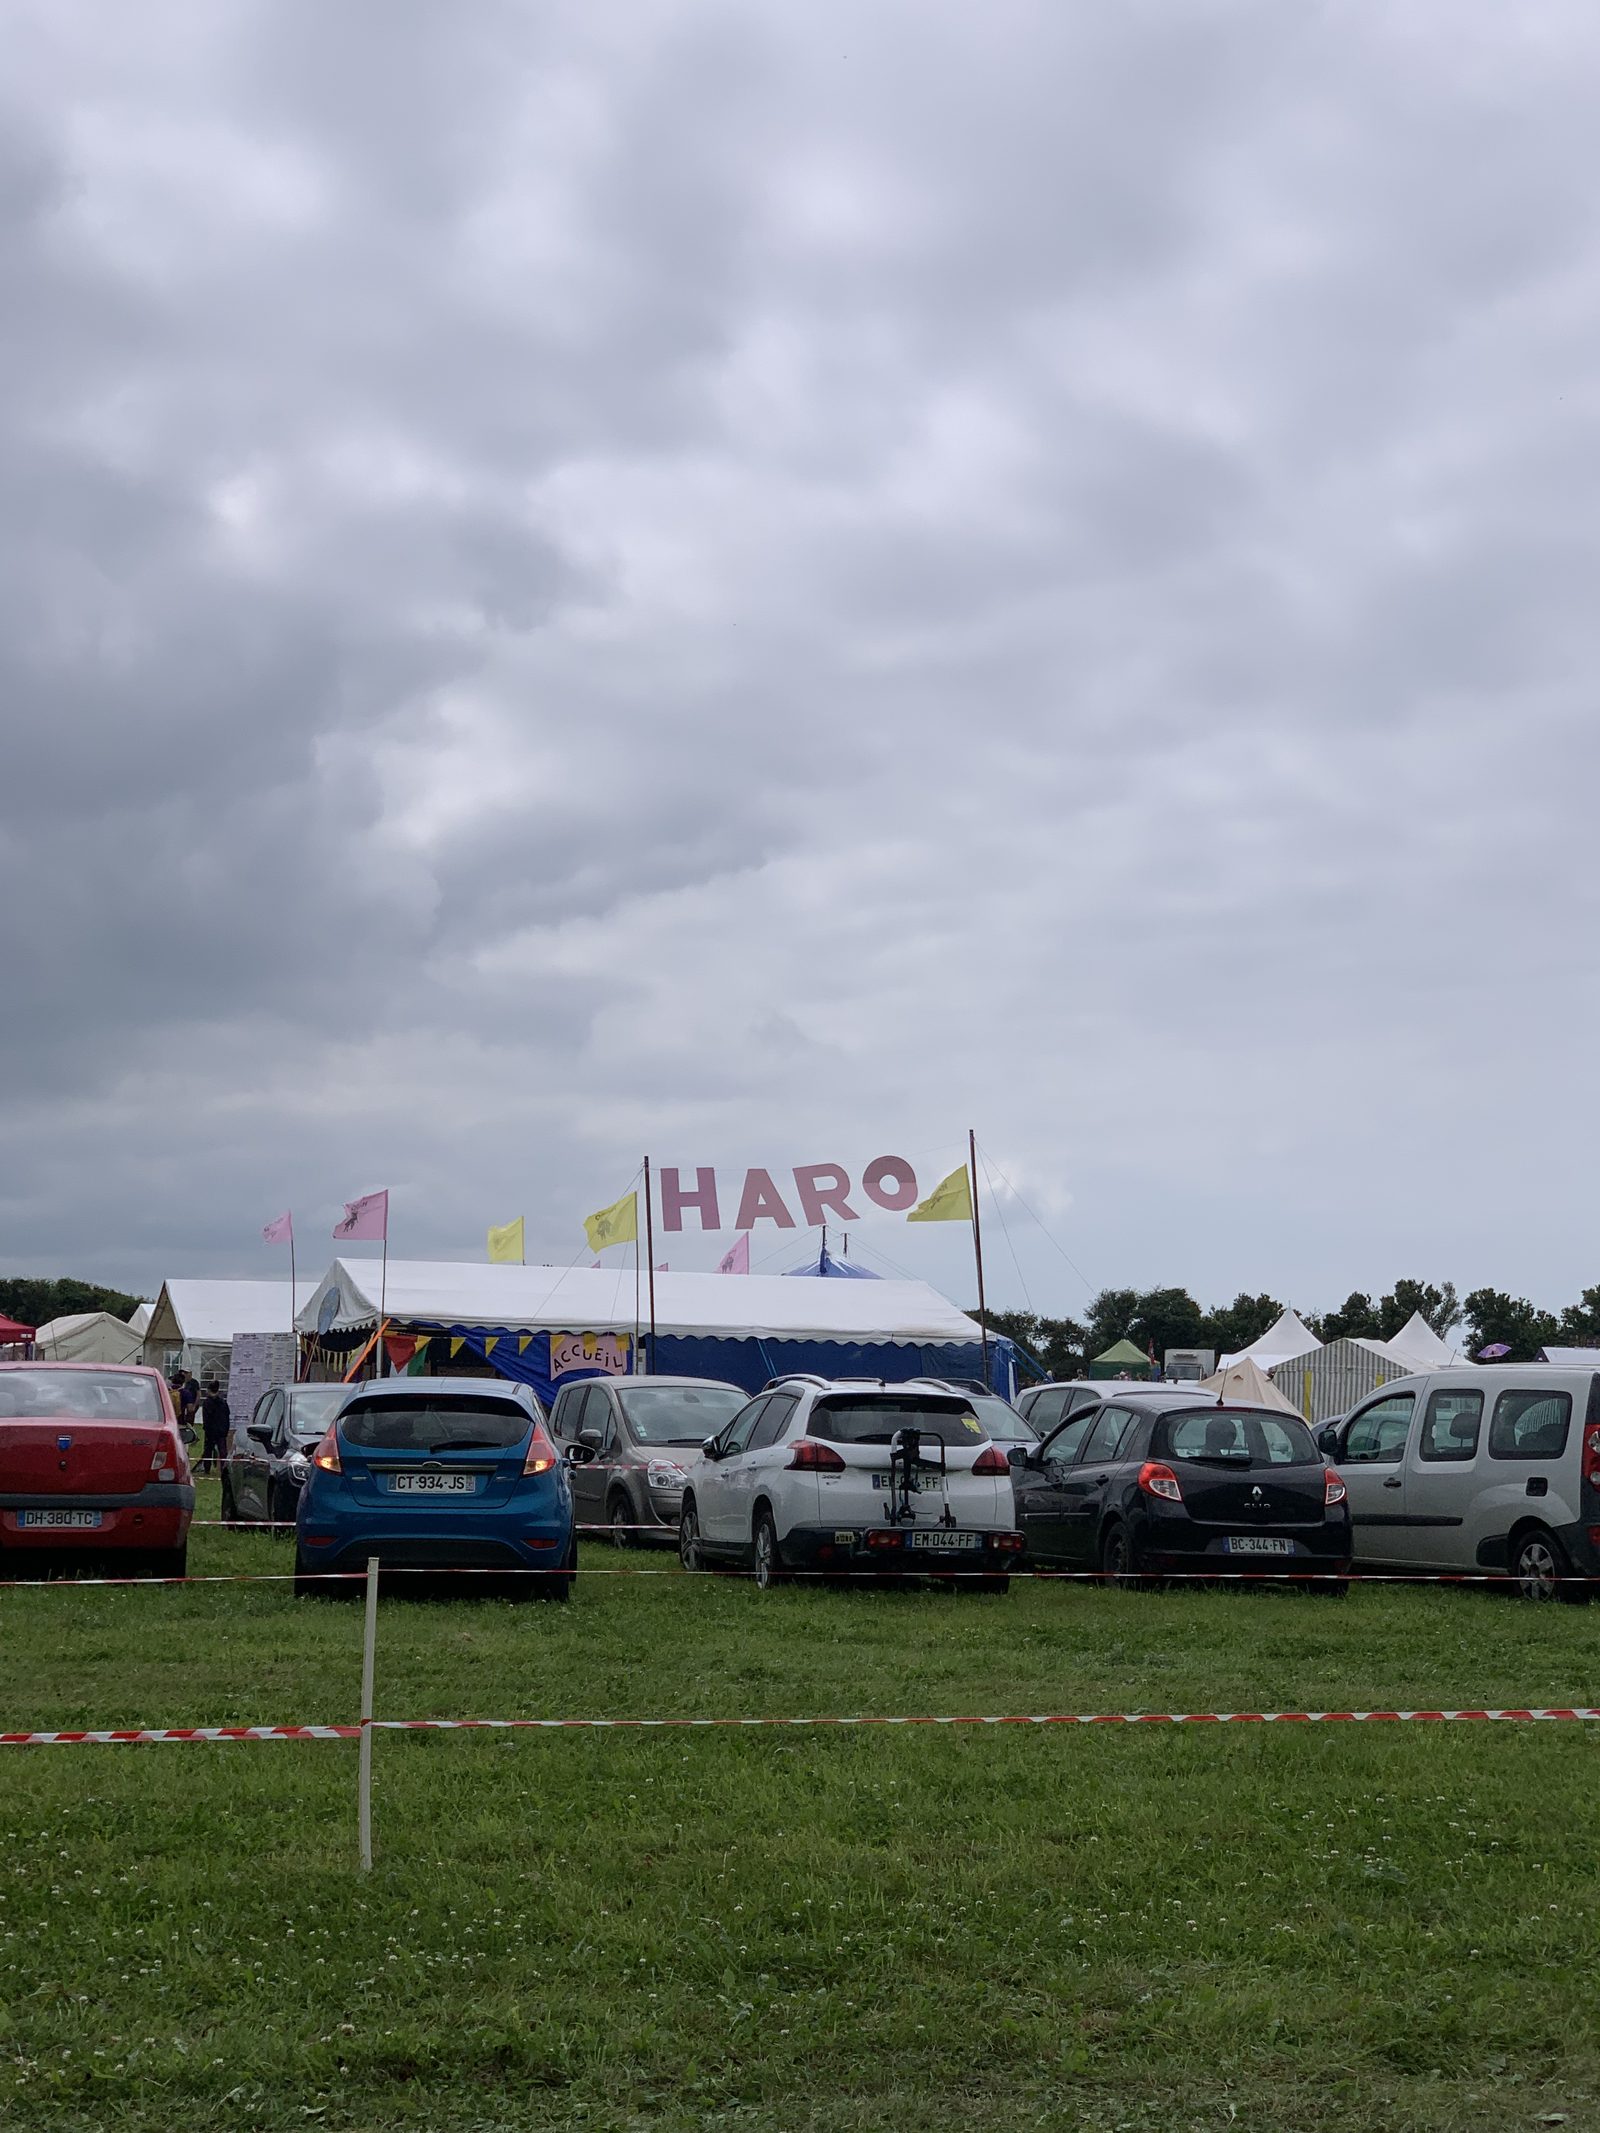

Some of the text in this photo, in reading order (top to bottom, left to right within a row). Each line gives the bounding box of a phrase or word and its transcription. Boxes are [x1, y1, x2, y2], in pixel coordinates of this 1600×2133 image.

[660, 1155, 918, 1232] HARO
[397, 1476, 465, 1489] CT-934-JS
[26, 1512, 93, 1525] DH-380-TC
[914, 1533, 974, 1547] EM-044-FF
[1230, 1538, 1287, 1552] BC-344-FN
